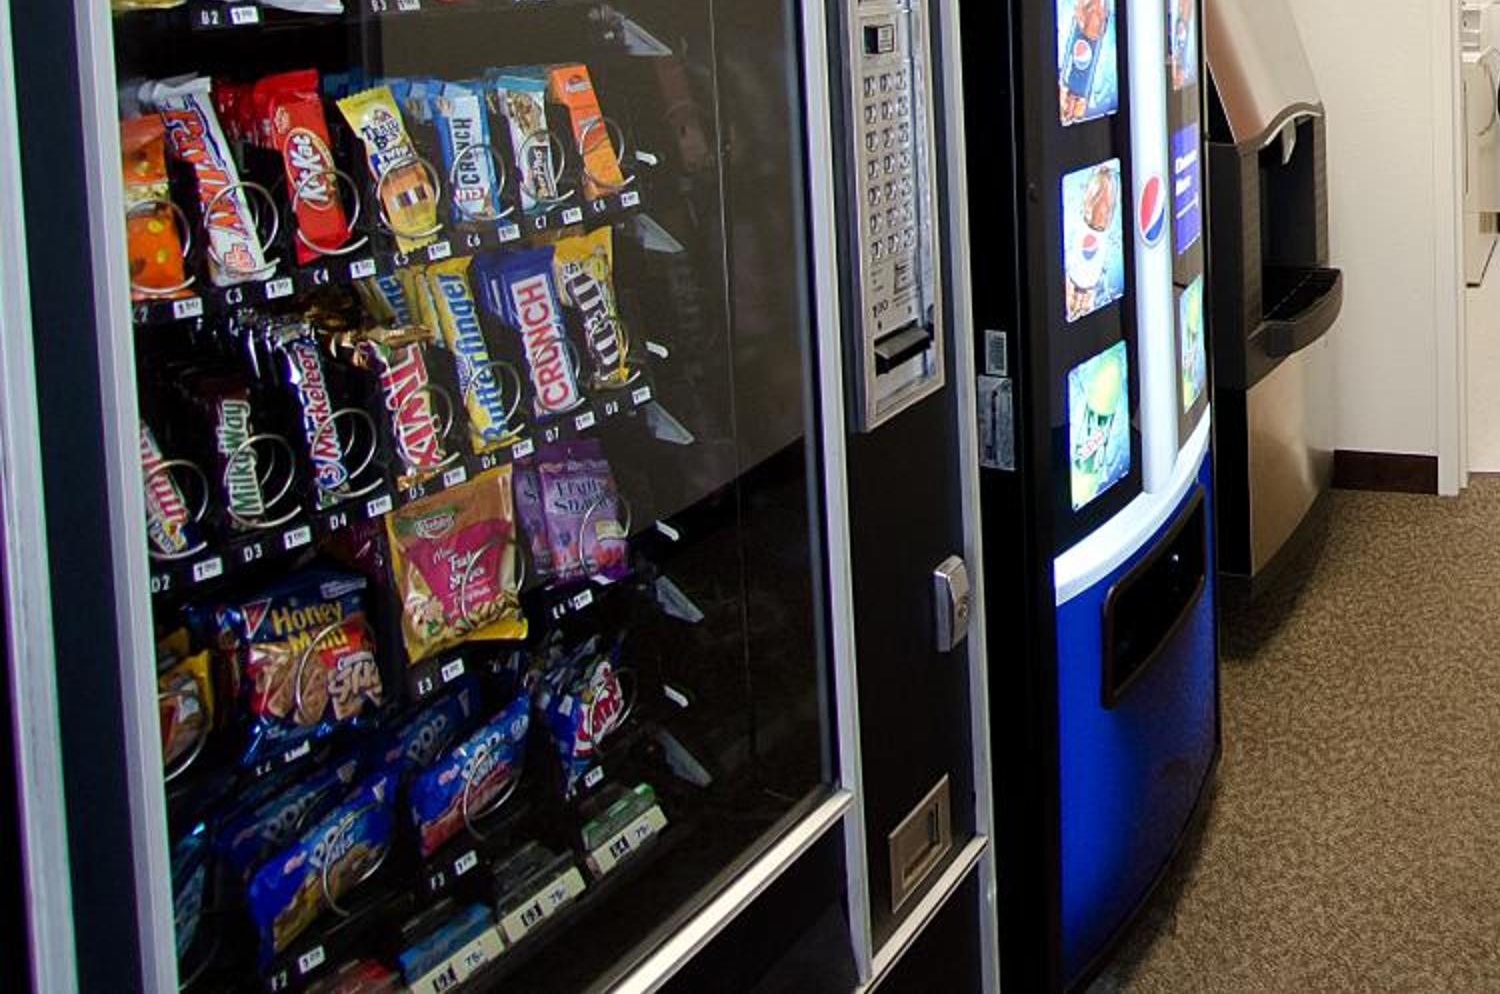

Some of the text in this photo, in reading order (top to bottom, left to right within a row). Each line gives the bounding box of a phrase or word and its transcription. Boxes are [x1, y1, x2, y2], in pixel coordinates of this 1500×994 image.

[313, 268, 330, 284] C4
[225, 287, 244, 305] C3
[438, 273, 509, 445] Butterfinger
[517, 280, 570, 407] CRUNCH
[297, 343, 342, 459] Musketeer
[218, 399, 252, 456] Way
[227, 446, 265, 515] Milky
[329, 511, 347, 531] D4
[243, 542, 263, 562] D3
[151, 574, 170, 593] D2
[271, 601, 343, 637] Honey
